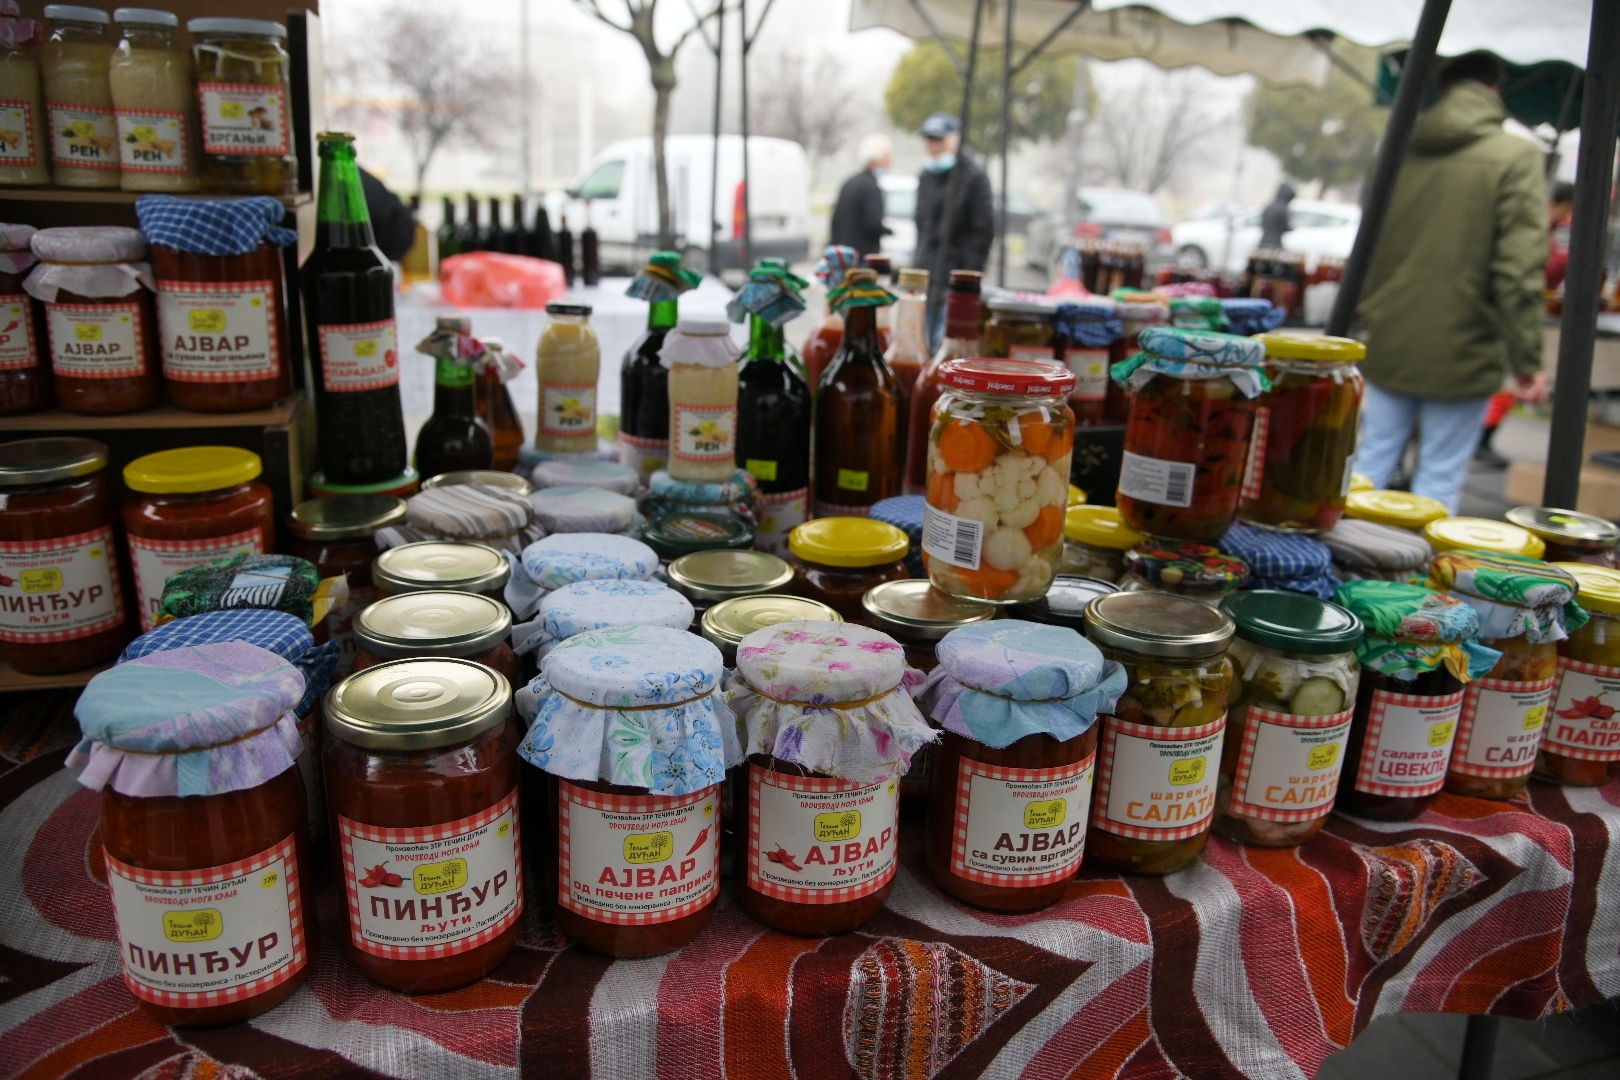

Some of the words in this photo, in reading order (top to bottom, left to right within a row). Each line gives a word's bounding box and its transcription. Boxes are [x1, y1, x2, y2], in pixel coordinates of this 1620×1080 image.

[70, 144, 100, 157] РЕН
[133, 149, 162, 162] РЕН
[64, 342, 121, 355] АЈВАР
[174, 335, 250, 352] АЈВАР
[694, 441, 719, 451] РЕН
[29, 613, 69, 625] љути
[1590, 720, 1620, 730] САЛ
[1556, 725, 1620, 747] ПАПР
[1381, 749, 1429, 760] салата
[1430, 749, 1443, 759] од
[1150, 785, 1209, 802] шарена
[1126, 792, 1214, 822] САЛАТА
[642, 813, 654, 821] ЗТР
[655, 811, 675, 819] ТЕЧИН
[1028, 817, 1056, 825] ДУЋАН
[609, 822, 650, 832] ПРОИЗВОДИ
[819, 828, 850, 838] ДУЋАН
[430, 842, 443, 850] ЗТР
[444, 836, 466, 847] ТЕЧИН
[993, 821, 1080, 852] АЈВАР
[804, 827, 891, 865] АЈВАР
[395, 852, 439, 862] ПРОИЗВОДИ
[629, 851, 661, 860] ДУЋАН
[972, 849, 988, 860] са
[992, 853, 1036, 865] сувим
[598, 857, 696, 887] АЈВАР
[832, 859, 874, 877] љути
[419, 873, 442, 882] Течин
[178, 887, 192, 895] ЗТР
[193, 885, 219, 894] ТЕЧИН
[220, 877, 247, 890] ДУЋАН
[420, 879, 455, 890] ДУЋАН
[573, 880, 591, 895] од
[595, 887, 654, 900] печене
[659, 869, 713, 898] паприке
[144, 895, 189, 907] ПРОИЗВОДИ
[214, 889, 238, 901] КРАЈА
[370, 869, 508, 920] ПИНЂУР
[168, 919, 193, 929] Течин
[420, 914, 471, 933] љути
[170, 928, 208, 938] ДУЋАН
[128, 931, 279, 975] ПИНЂУР
[163, 979, 176, 988] без
[177, 978, 229, 989] конзерванса
[234, 953, 289, 981] Пастеризовано
